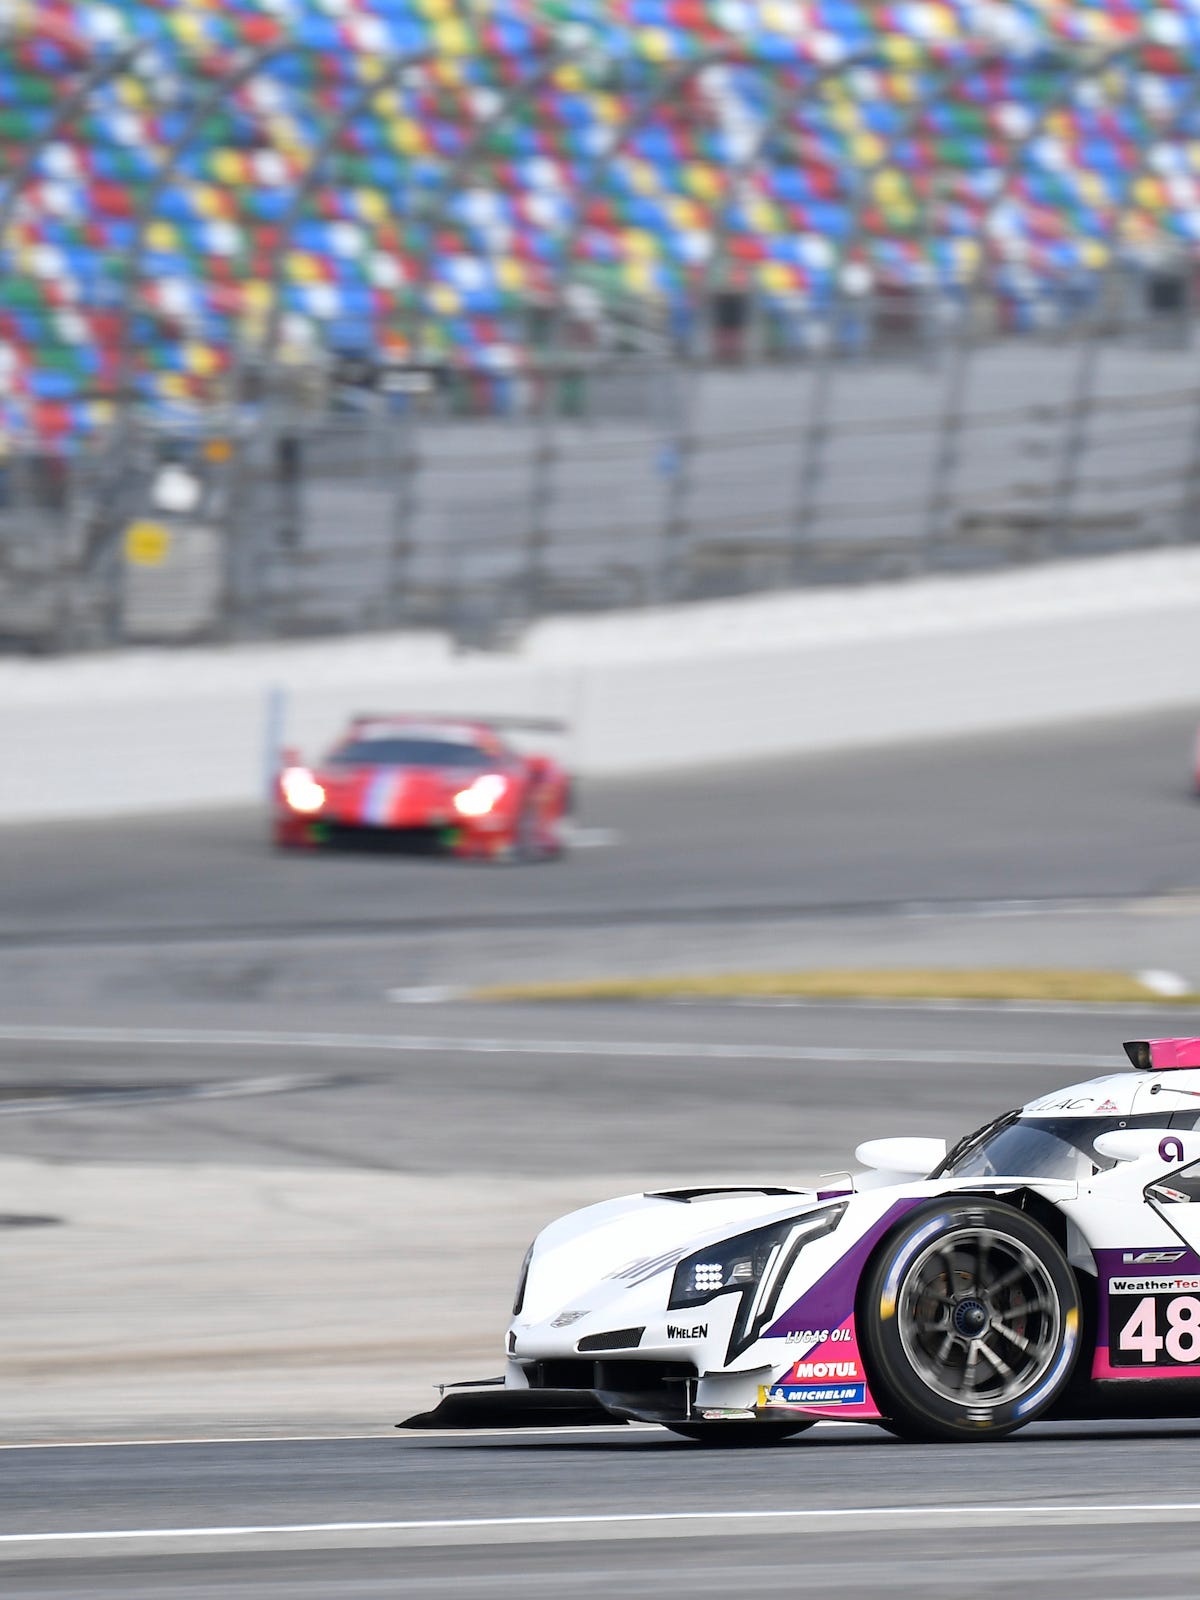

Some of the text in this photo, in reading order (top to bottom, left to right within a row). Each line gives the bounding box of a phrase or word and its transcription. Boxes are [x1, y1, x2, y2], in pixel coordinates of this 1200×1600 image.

[667, 1323, 708, 1339] WHELEN
[785, 1328, 852, 1344] LUCAS OIL
[796, 1362, 858, 1378] MOTUL
[787, 1389, 857, 1400] MICHELIN
